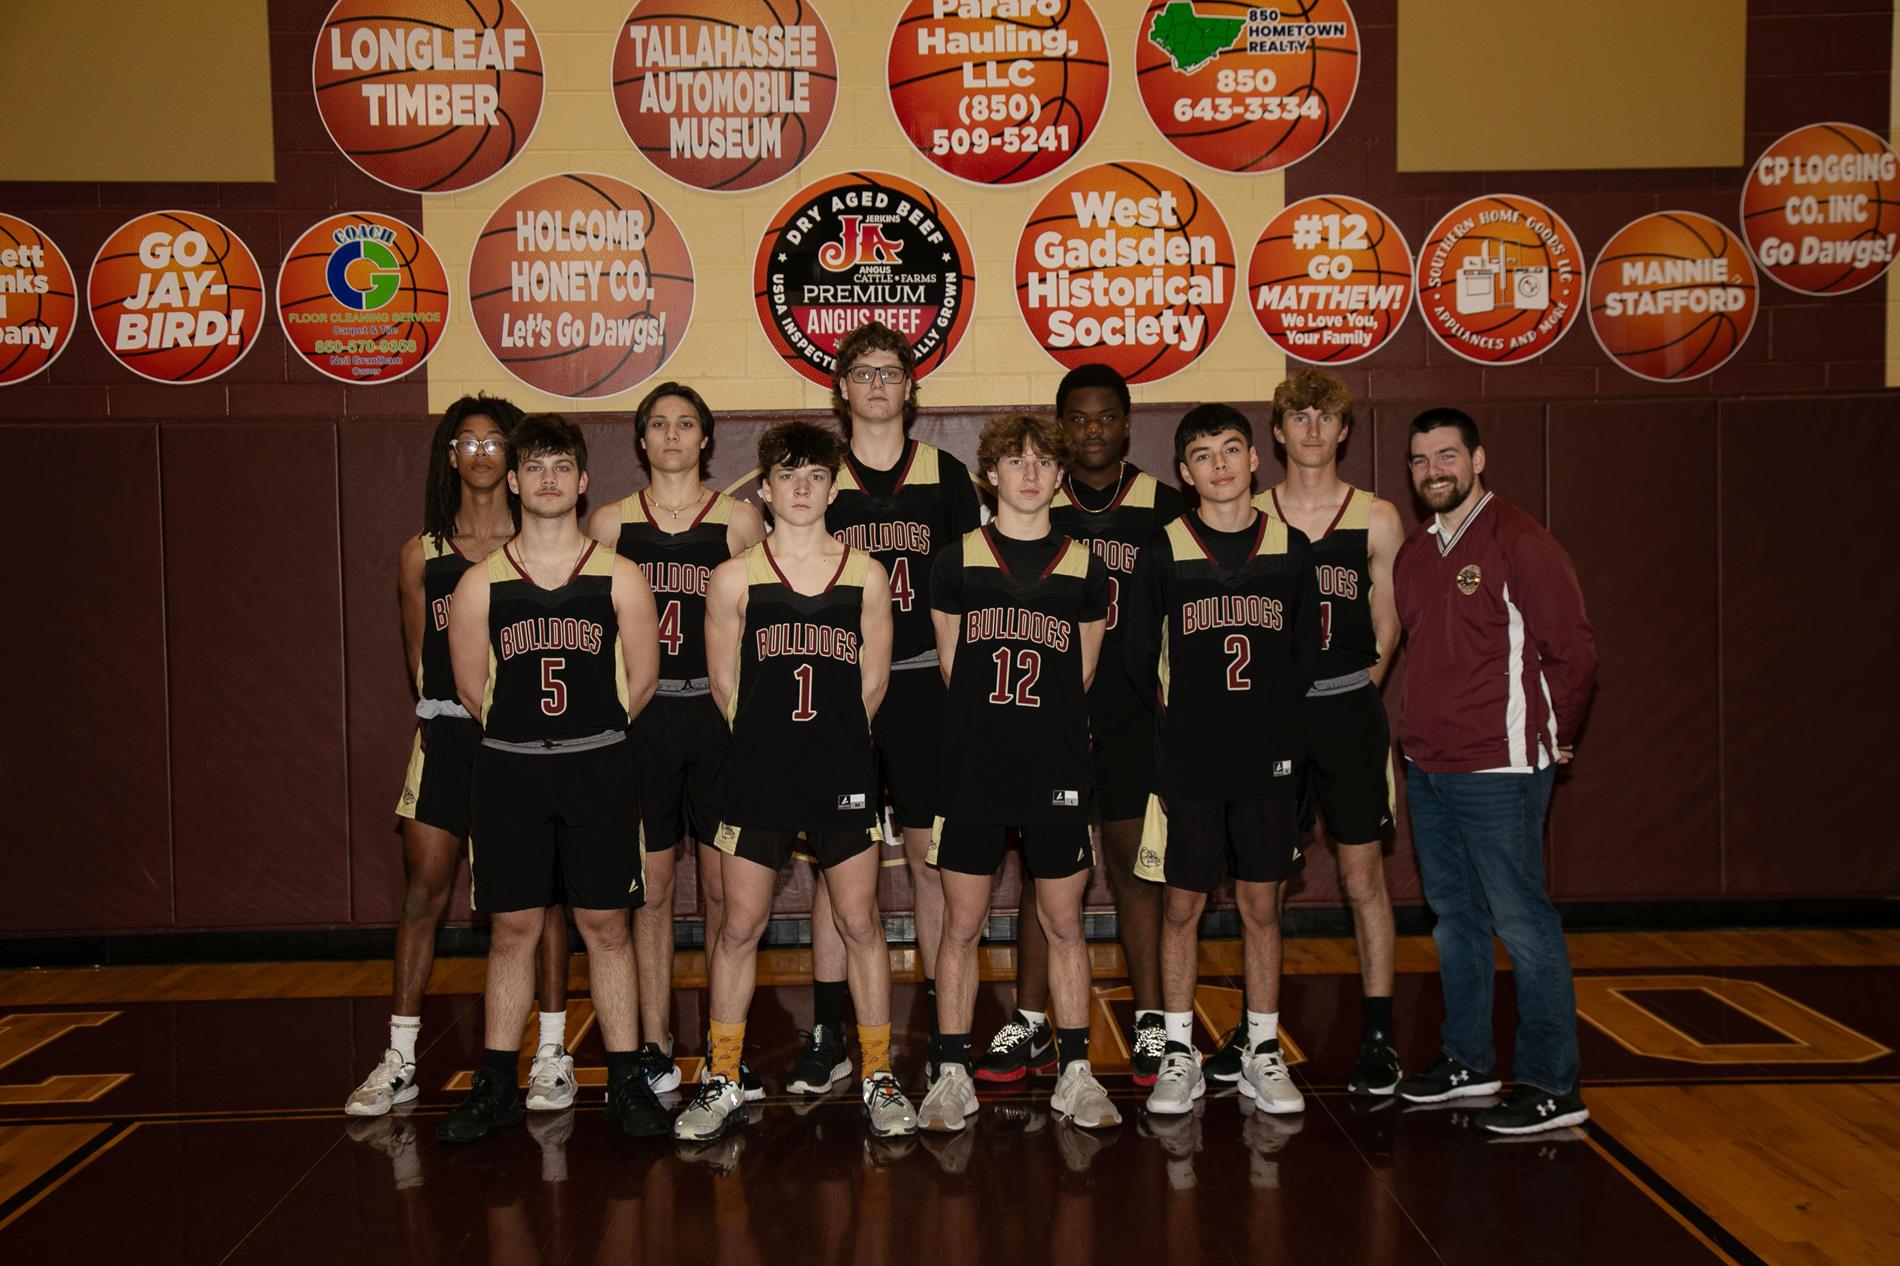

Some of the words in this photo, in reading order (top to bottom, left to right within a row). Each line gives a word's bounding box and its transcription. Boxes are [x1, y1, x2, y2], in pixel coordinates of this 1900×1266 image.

[933, 0, 1062, 19] Pararo
[1249, 9, 1279, 22] 850
[630, 24, 817, 68] TALLAHASSEE
[918, 24, 1079, 57] Hauling,
[1249, 23, 1345, 37] HOMETOWN
[1249, 40, 1307, 52] REALTY
[331, 28, 526, 71] LONGLEAF
[963, 60, 1035, 88] LLC
[1217, 69, 1277, 94] 850
[362, 84, 500, 126] TIMBER
[640, 71, 811, 114] AUTOMOBILE
[958, 94, 1042, 126] (850)
[1173, 97, 1322, 122] 643-3334
[669, 117, 782, 160] MUSEUM
[932, 125, 1070, 155] 509-5241
[1759, 156, 1790, 186] CP
[1793, 152, 1897, 184] LOGGING
[786, 204, 822, 246] DRY
[831, 191, 889, 213] AGED
[896, 200, 944, 245] BEEF
[865, 214, 900, 223] JERKINS
[1071, 190, 1178, 229] West
[1785, 196, 1825, 225] CO.
[1829, 193, 1869, 224] INC
[333, 224, 397, 246] COACH
[516, 209, 646, 252] HOLCOMB
[1293, 214, 1368, 250] #12
[0, 245, 44, 268] ett
[139, 231, 209, 269] GO
[1034, 228, 1216, 269] Gadsden
[1428, 217, 1475, 288] SOUTHERN
[1478, 209, 1521, 225] HOME
[1525, 216, 1566, 256] GOODS
[1760, 237, 1795, 267] Go
[1799, 233, 1897, 269] Dawgs!
[0, 269, 49, 294] nks
[511, 260, 603, 303] HONEY
[609, 259, 656, 301] CO.
[853, 274, 894, 284] CATTLE
[900, 274, 937, 284] FARMS
[859, 265, 891, 274] ANGUS
[1308, 255, 1353, 280] GO
[1622, 258, 1728, 286] MANNIE
[122, 268, 228, 311] JAY-
[803, 285, 926, 304] PREMIUM
[1028, 266, 1224, 309] Historical
[1256, 285, 1404, 310] MATTHEW!
[1605, 288, 1746, 317] STAFFORD
[115, 308, 245, 351] BIRD!
[289, 312, 328, 324] FLOOR
[330, 312, 390, 323] CLEANING
[391, 311, 441, 323] SERVICE
[332, 324, 368, 337] Carpet
[369, 325, 377, 335] &
[500, 312, 554, 348] Let's
[556, 312, 584, 348] Go
[588, 311, 666, 354] Dawgs!
[773, 273, 788, 316] USDA
[781, 317, 838, 371] INSPECTE
[807, 309, 870, 334] ANGUS
[913, 327, 941, 361] ALLY
[937, 272, 957, 328] GROWN
[1047, 308, 1206, 352] Society
[1281, 313, 1306, 327] We
[1308, 313, 1343, 327] Love
[1346, 313, 1378, 330] You,
[1434, 306, 1504, 350] APPLIANCES
[1510, 331, 1537, 348] AND
[1539, 301, 1569, 335] MORE
[1286, 330, 1321, 345] Your
[1323, 330, 1373, 347] Family
[352, 355, 402, 366] Grantham
[352, 367, 382, 376] Owner
[639, 562, 714, 597] LLDOG
[889, 557, 915, 612] 4
[1315, 565, 1358, 600] OGS
[659, 600, 684, 656] 4
[966, 607, 1071, 653] BULLDOGS
[1183, 594, 1284, 636] BULLDOGS
[501, 617, 603, 661] BULLDOGS
[756, 622, 858, 665] BULLDOGS
[989, 646, 1041, 708] 12
[1224, 634, 1251, 691] 2
[540, 657, 568, 717] 5
[792, 663, 818, 721] 1
